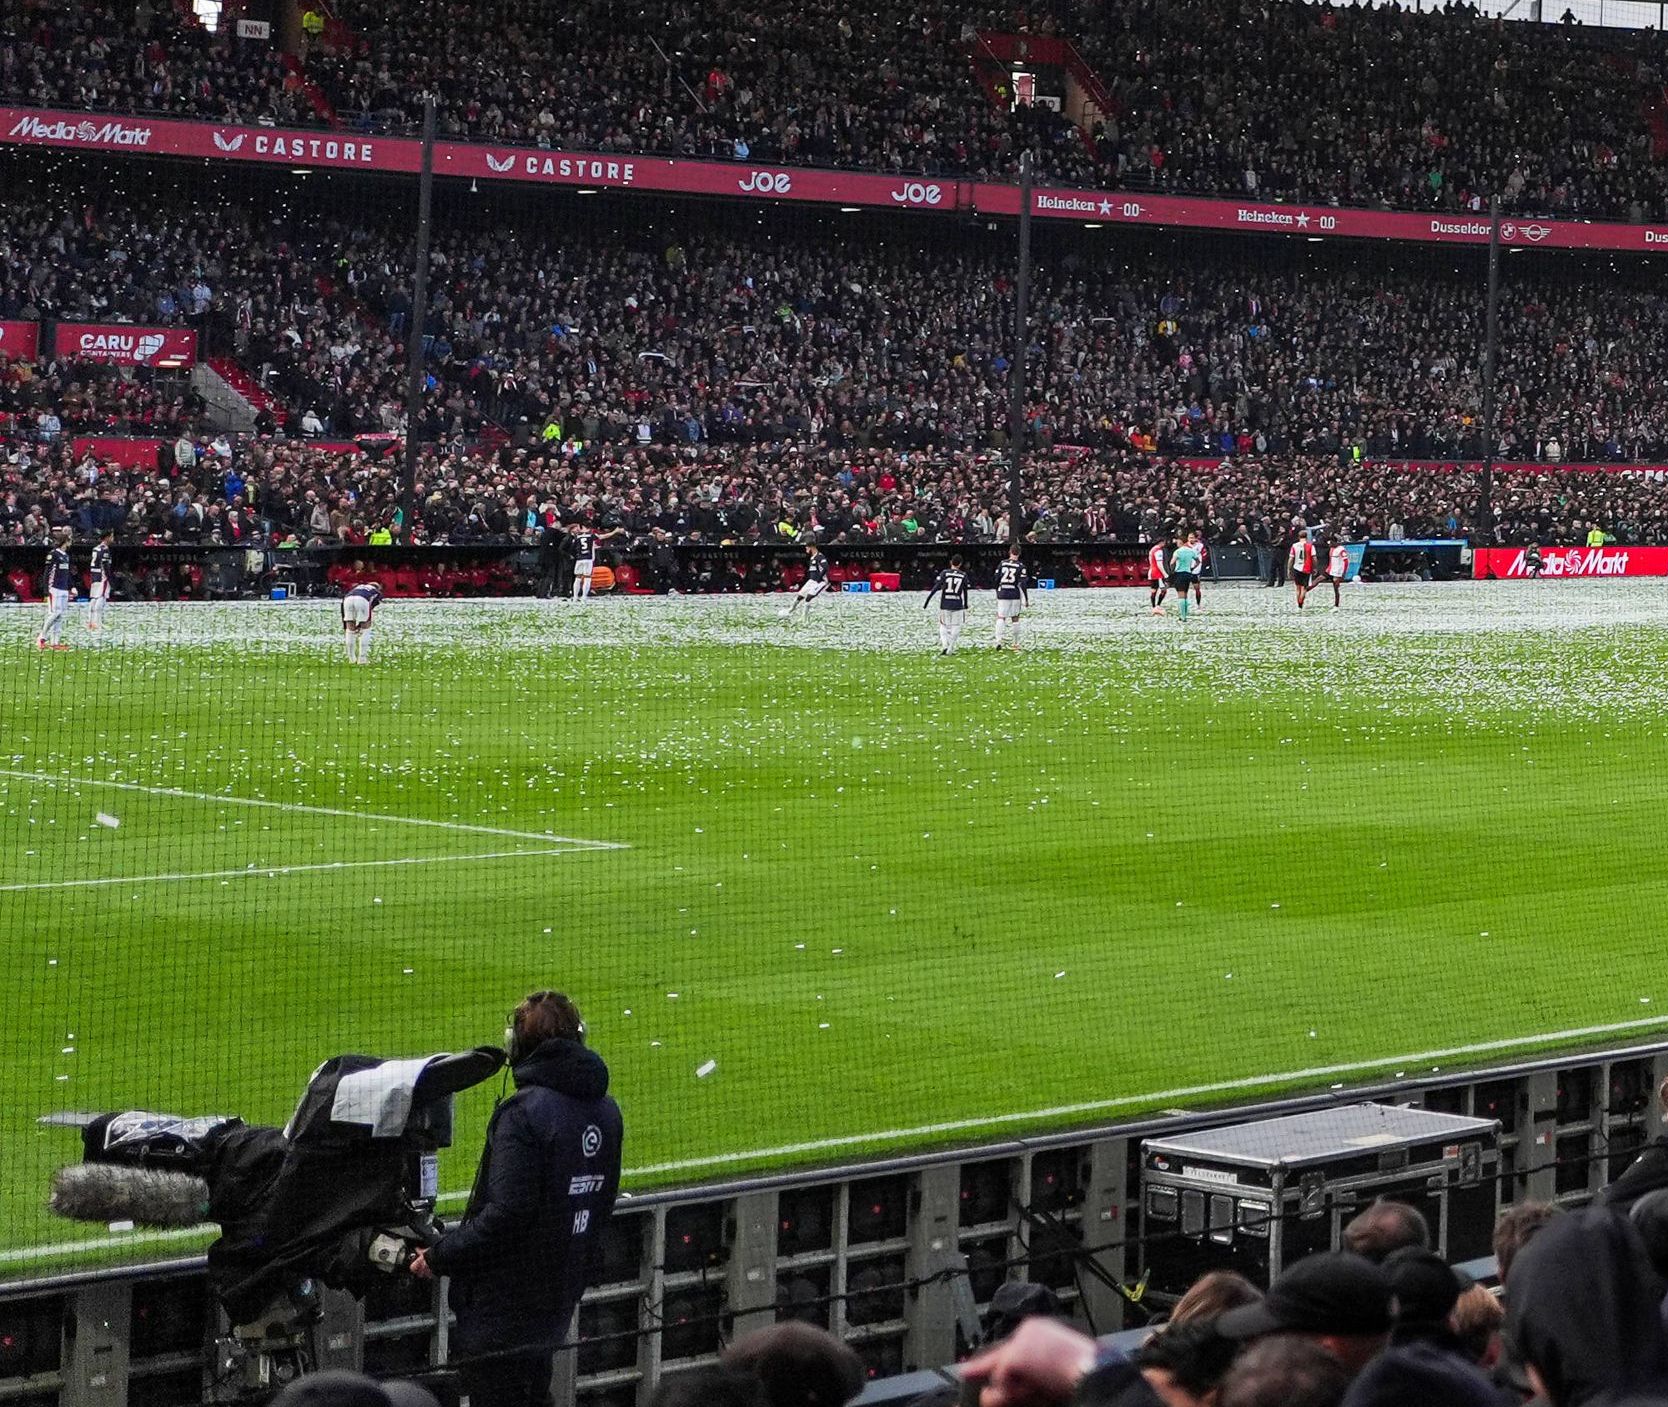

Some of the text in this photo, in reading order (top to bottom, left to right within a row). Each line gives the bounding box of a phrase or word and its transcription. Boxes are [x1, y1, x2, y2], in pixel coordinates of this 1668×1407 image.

[244, 24, 263, 35] NN
[255, 135, 373, 162] CASTORE
[525, 156, 635, 181] CASTORE
[1037, 195, 1096, 212] Heineken
[1237, 209, 1293, 225] Heineken
[1430, 220, 1491, 236] Dusseldor
[79, 333, 134, 351] CARU
[579, 537, 588, 550] 5
[1506, 549, 1566, 576] Mdia
[1000, 566, 1016, 583] 23
[944, 576, 962, 593] 17
[572, 1209, 590, 1235] HB
